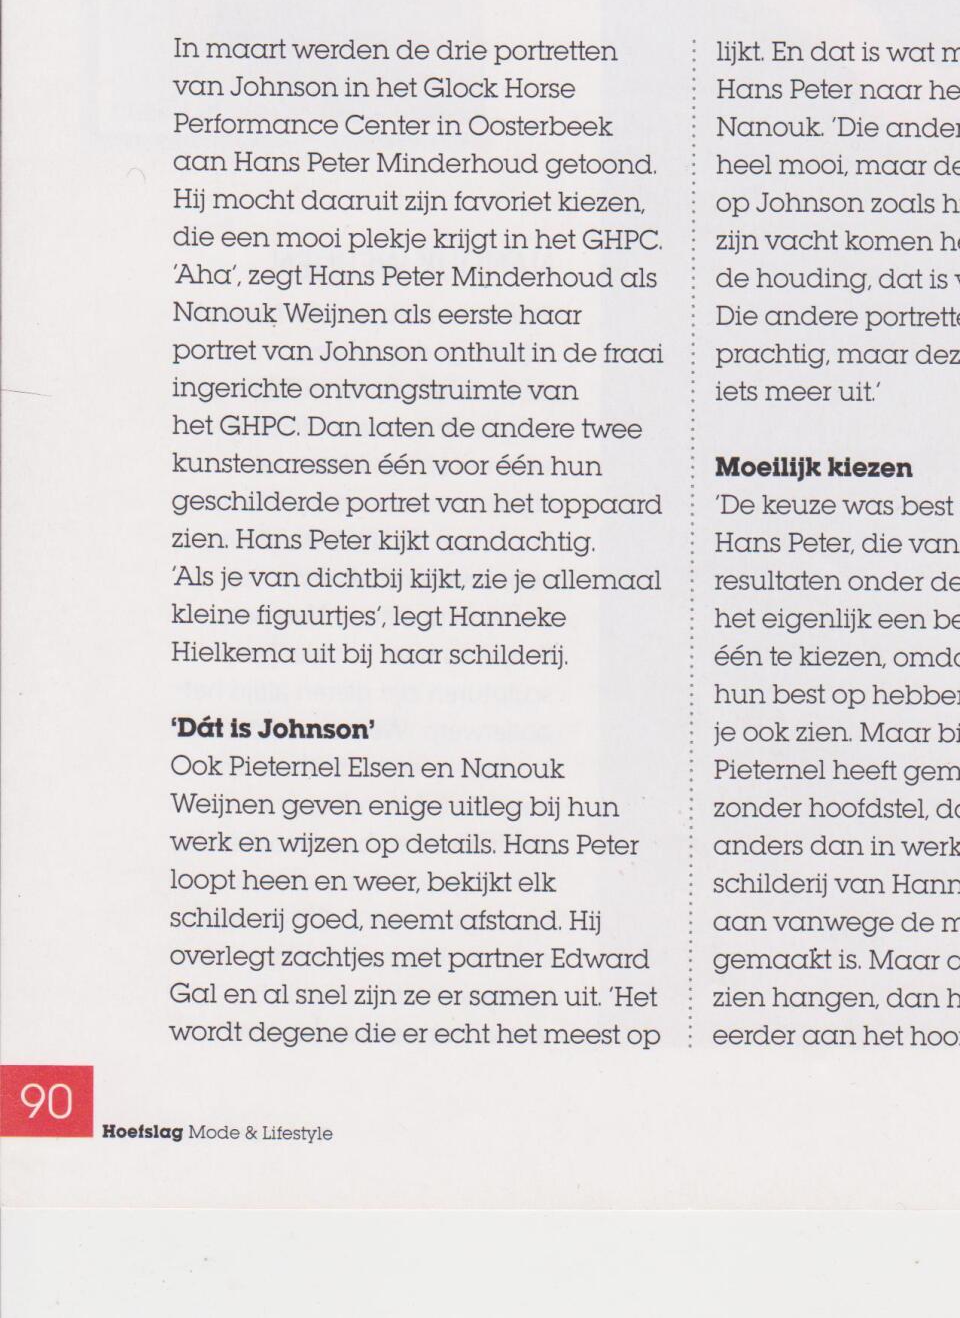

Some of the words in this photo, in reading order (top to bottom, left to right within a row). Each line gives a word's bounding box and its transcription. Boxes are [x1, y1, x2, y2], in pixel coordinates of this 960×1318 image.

[174, 37, 199, 58] In
[206, 39, 286, 59] maart
[292, 39, 390, 60] werden
[396, 40, 429, 60] de
[436, 40, 487, 60] drie
[494, 40, 618, 65] portretten
[717, 79, 782, 99] Hans
[790, 79, 853, 99] Peter
[860, 84, 922, 100] naar
[174, 113, 338, 135] Performance
[345, 114, 430, 135] Center
[437, 115, 462, 135] in
[469, 115, 613, 136] Oosterbeek
[173, 155, 227, 171] aan
[234, 151, 300, 172] Hans
[307, 152, 370, 172] Peter
[377, 153, 538, 174] Minderhoud
[546, 154, 656, 179] getoond.
[716, 230, 759, 255] zijn
[765, 230, 838, 250] vacht
[845, 230, 933, 251] komen
[716, 305, 758, 326] Die
[765, 306, 858, 326] andere
[172, 377, 302, 403] ingerichte
[309, 379, 521, 405] ontvangstruimte
[527, 385, 579, 400] van
[715, 456, 821, 482] Moeilijk
[828, 457, 913, 478] kiezen
[172, 491, 339, 515] geschilderde
[346, 492, 430, 517] portret
[435, 498, 487, 513] van
[493, 493, 534, 513] het
[540, 493, 662, 519] toppaard
[172, 528, 228, 548] zien.
[236, 529, 302, 550] Hans
[309, 529, 372, 550] Peter
[378, 530, 429, 555] kijkt
[436, 531, 595, 557] aandachtig.
[171, 641, 296, 663] Hielkema
[302, 643, 336, 663] uit
[342, 643, 372, 669] bij
[380, 644, 443, 664] haar
[450, 644, 568, 670] schilderij.
[230, 718, 251, 738] is
[171, 754, 223, 776] Ook
[229, 756, 341, 777] Pieternel
[348, 757, 415, 778] Elsen
[421, 762, 454, 778] en
[461, 758, 565, 778] Nanouk
[714, 759, 826, 780] Pieternel
[833, 760, 897, 780] heeft
[713, 873, 827, 898] schilderij
[834, 878, 885, 894] van
[170, 946, 275, 971] overlegt
[281, 947, 384, 972] zachtjes
[392, 947, 442, 967] met
[448, 948, 544, 973] partner
[551, 948, 650, 969] Edward
[21, 1083, 72, 1119] 90
[102, 1124, 183, 1142] Hoefslag
[189, 1125, 240, 1139] Mode
[245, 1126, 257, 1140] &
[262, 1126, 333, 1144] Lifestyle
